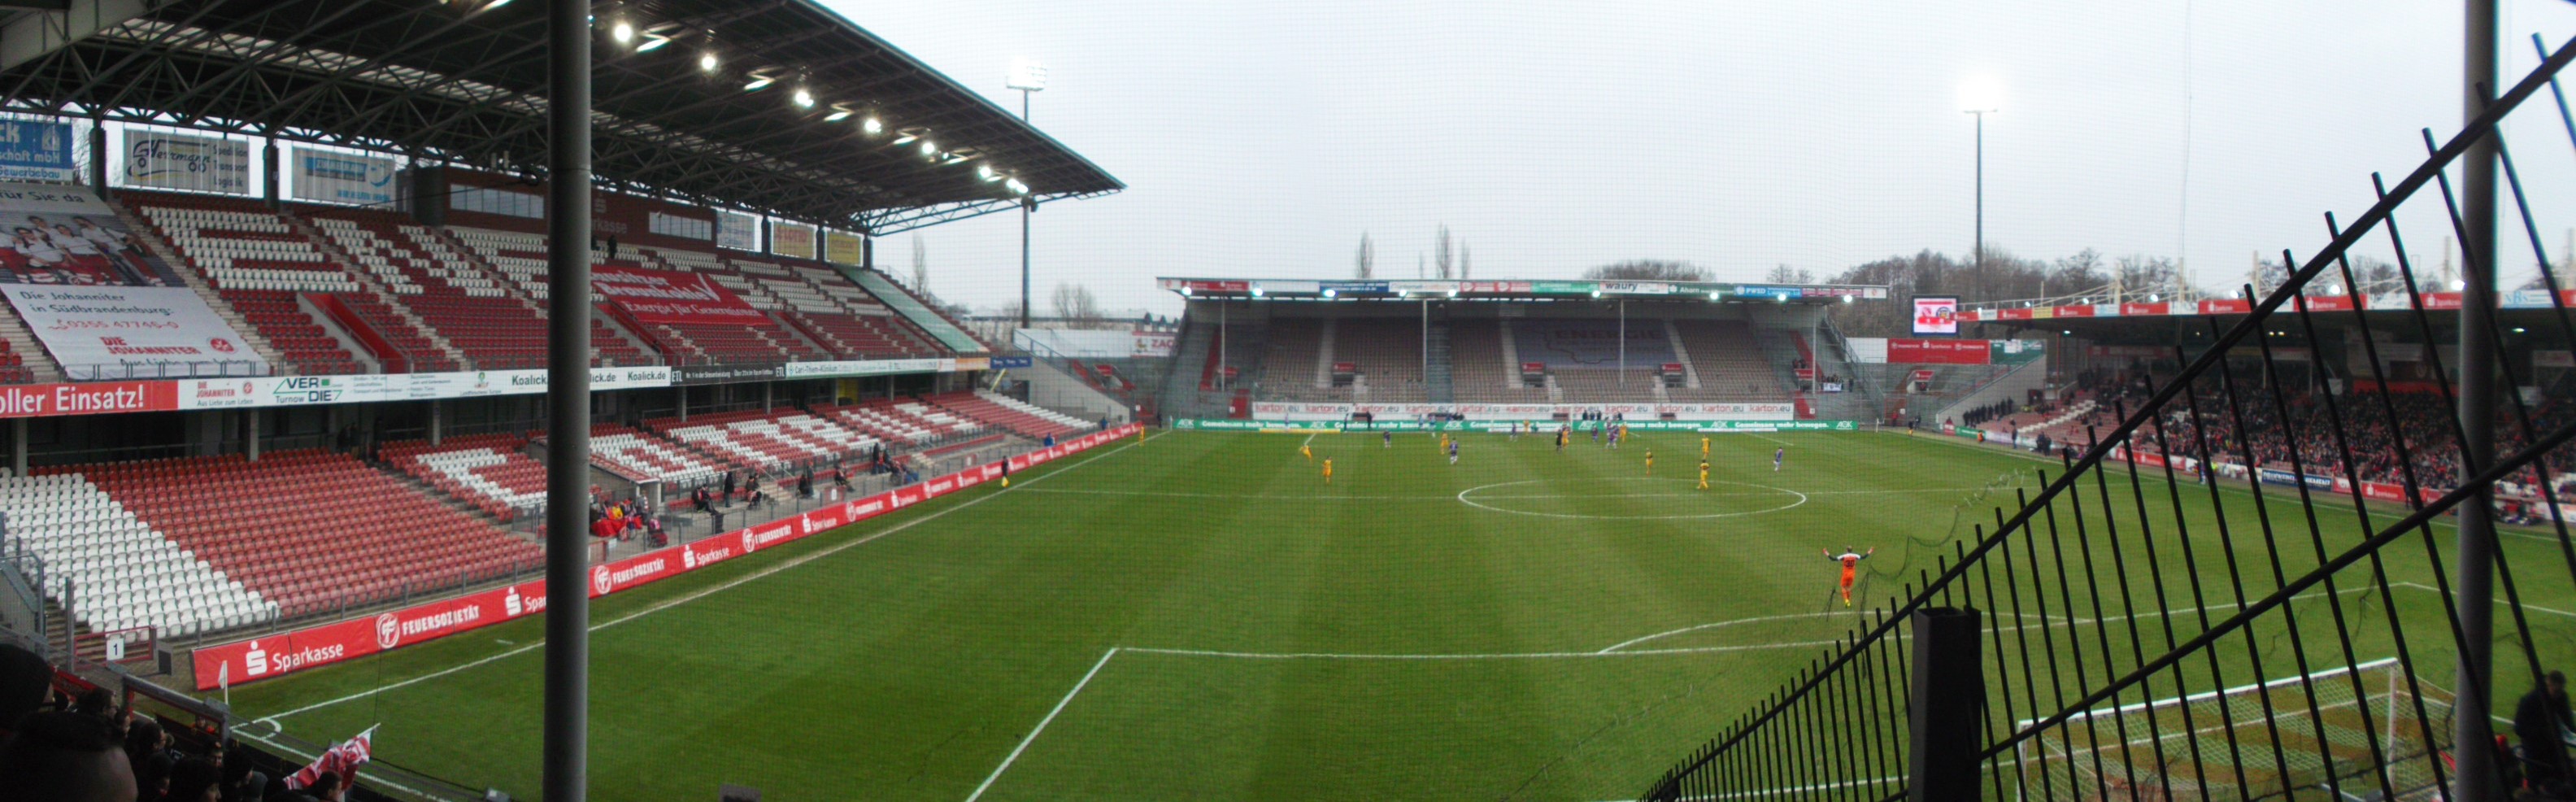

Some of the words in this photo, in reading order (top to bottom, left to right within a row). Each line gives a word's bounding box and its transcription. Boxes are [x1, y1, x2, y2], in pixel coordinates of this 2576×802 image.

[0, 148, 30, 162] chaft
[34, 150, 60, 163] mbH
[28, 191, 59, 203] Sie
[63, 193, 85, 203] da
[1605, 282, 1638, 292] waury
[20, 290, 46, 300] Die
[50, 291, 126, 302] Johanniter
[29, 303, 46, 313] in
[49, 303, 175, 316] Südbrandenburg:
[99, 336, 128, 347] DIE
[107, 346, 202, 355] JOHANNITER
[590, 373, 616, 383] lick.de
[628, 371, 666, 381] Koalick.de
[672, 370, 682, 382] ETL
[776, 367, 785, 377] ETL
[198, 381, 207, 390] DIE
[285, 377, 320, 390] VER
[511, 374, 548, 386] Koalick.
[56, 384, 144, 412] Einsatz!
[196, 389, 236, 399] JOHANNITER
[276, 395, 304, 403] Turnow
[308, 390, 332, 402] DIE
[1605, 403, 1648, 413] karton.eu
[1702, 403, 1744, 413] karton.eu
[1750, 403, 1791, 413] karton.eu
[1795, 421, 1830, 429] bewegen.
[1836, 420, 1854, 429] AOK
[696, 547, 729, 567] Sparkasse
[524, 595, 546, 612] Spar
[402, 604, 480, 635] FEUERSOZIETÄT
[112, 644, 119, 656] 1
[272, 643, 344, 672] Sparkasse
